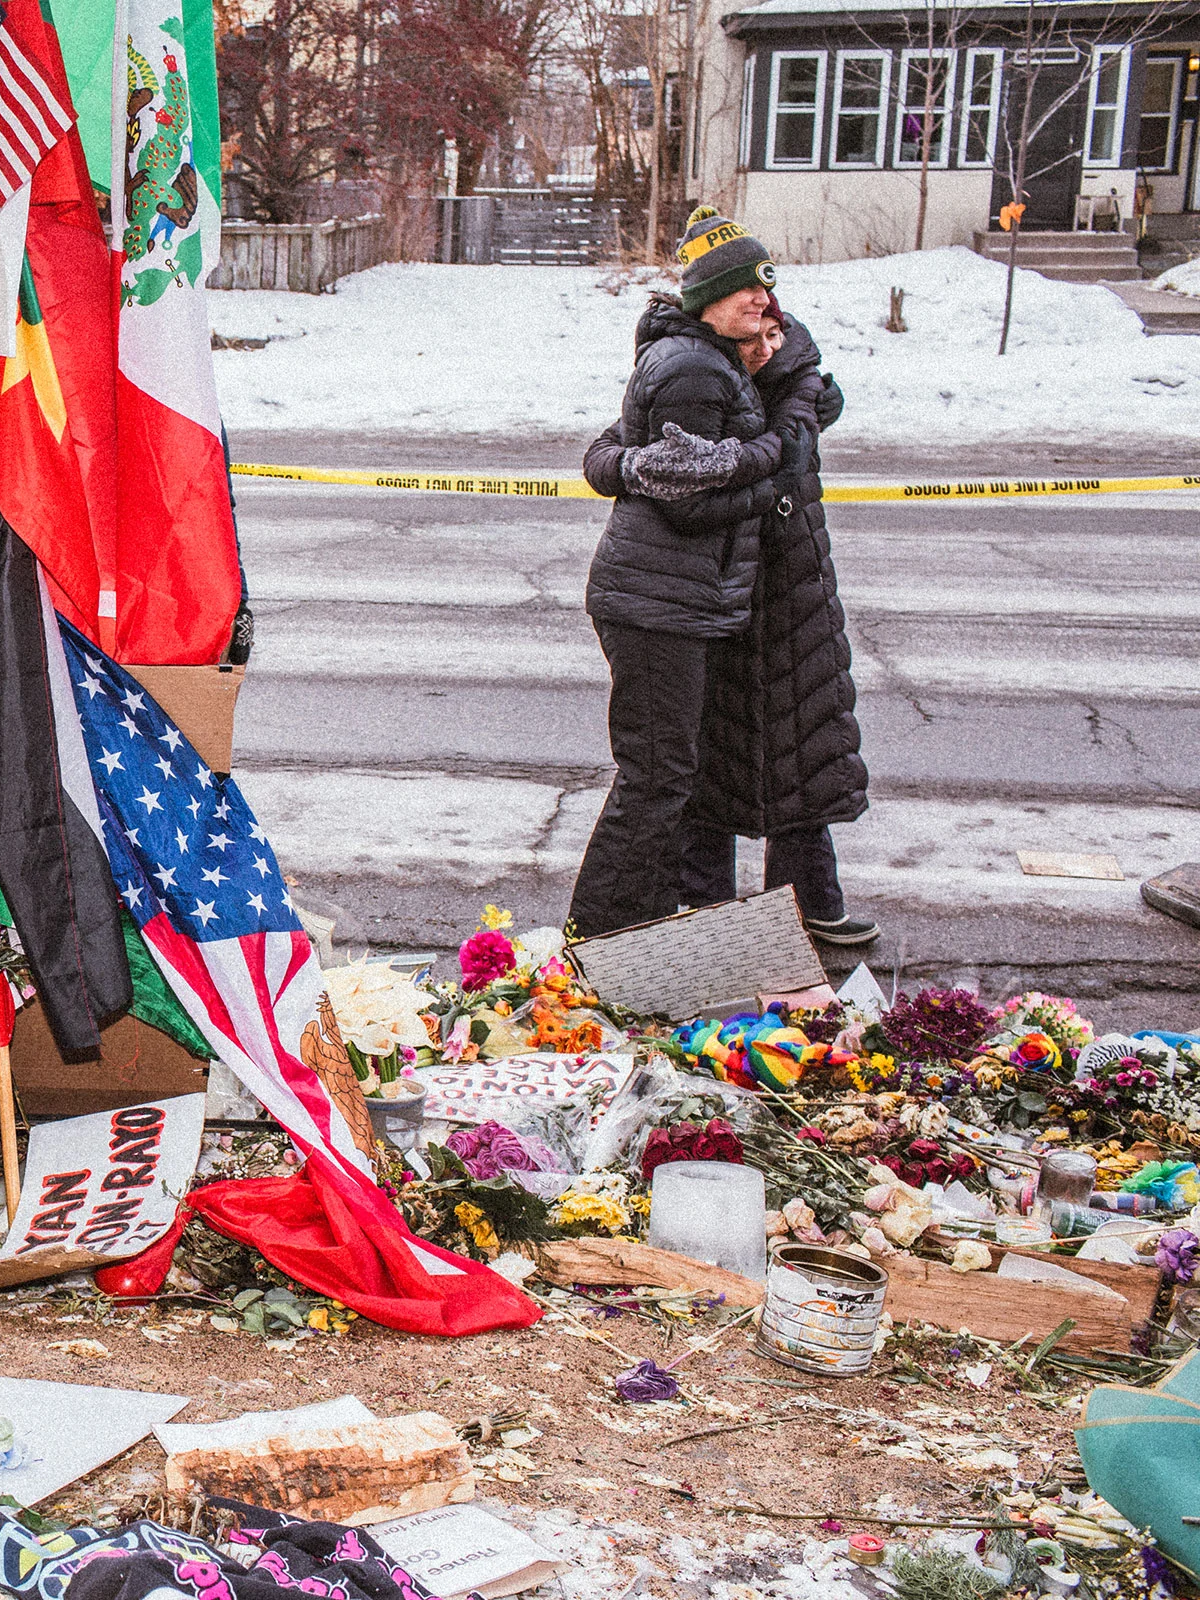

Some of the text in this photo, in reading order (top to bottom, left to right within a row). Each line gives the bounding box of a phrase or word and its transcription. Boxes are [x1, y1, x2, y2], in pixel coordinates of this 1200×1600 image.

[478, 480, 508, 494] LINE
[512, 481, 558, 497] POLICE
[409, 1509, 462, 1527] martyr
[383, 1523, 408, 1537] for
[396, 1548, 442, 1568] Goo
[428, 1547, 500, 1577] Renee
